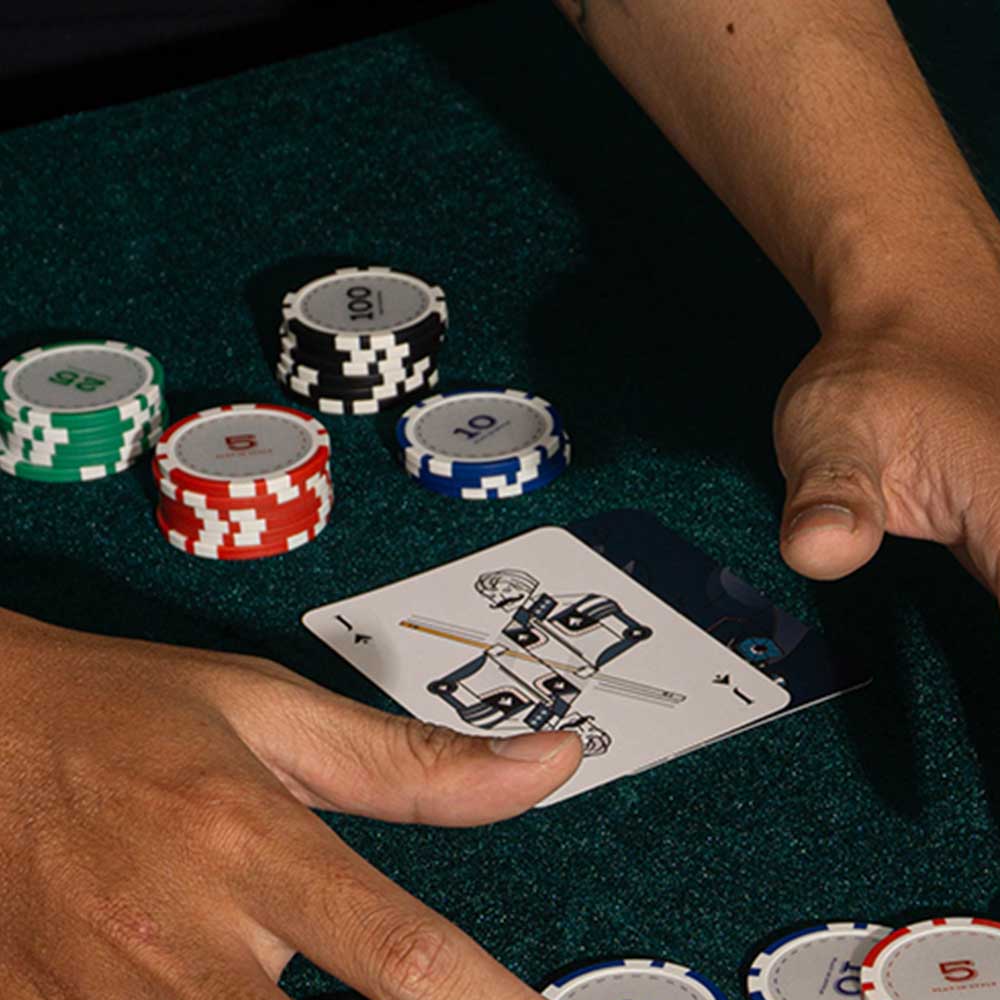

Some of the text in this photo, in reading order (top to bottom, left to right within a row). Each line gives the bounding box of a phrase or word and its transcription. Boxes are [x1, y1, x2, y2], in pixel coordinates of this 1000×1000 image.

[347, 286, 373, 320] 100
[453, 414, 497, 440] 10
[224, 433, 257, 452] 5
[939, 959, 978, 983] 5
